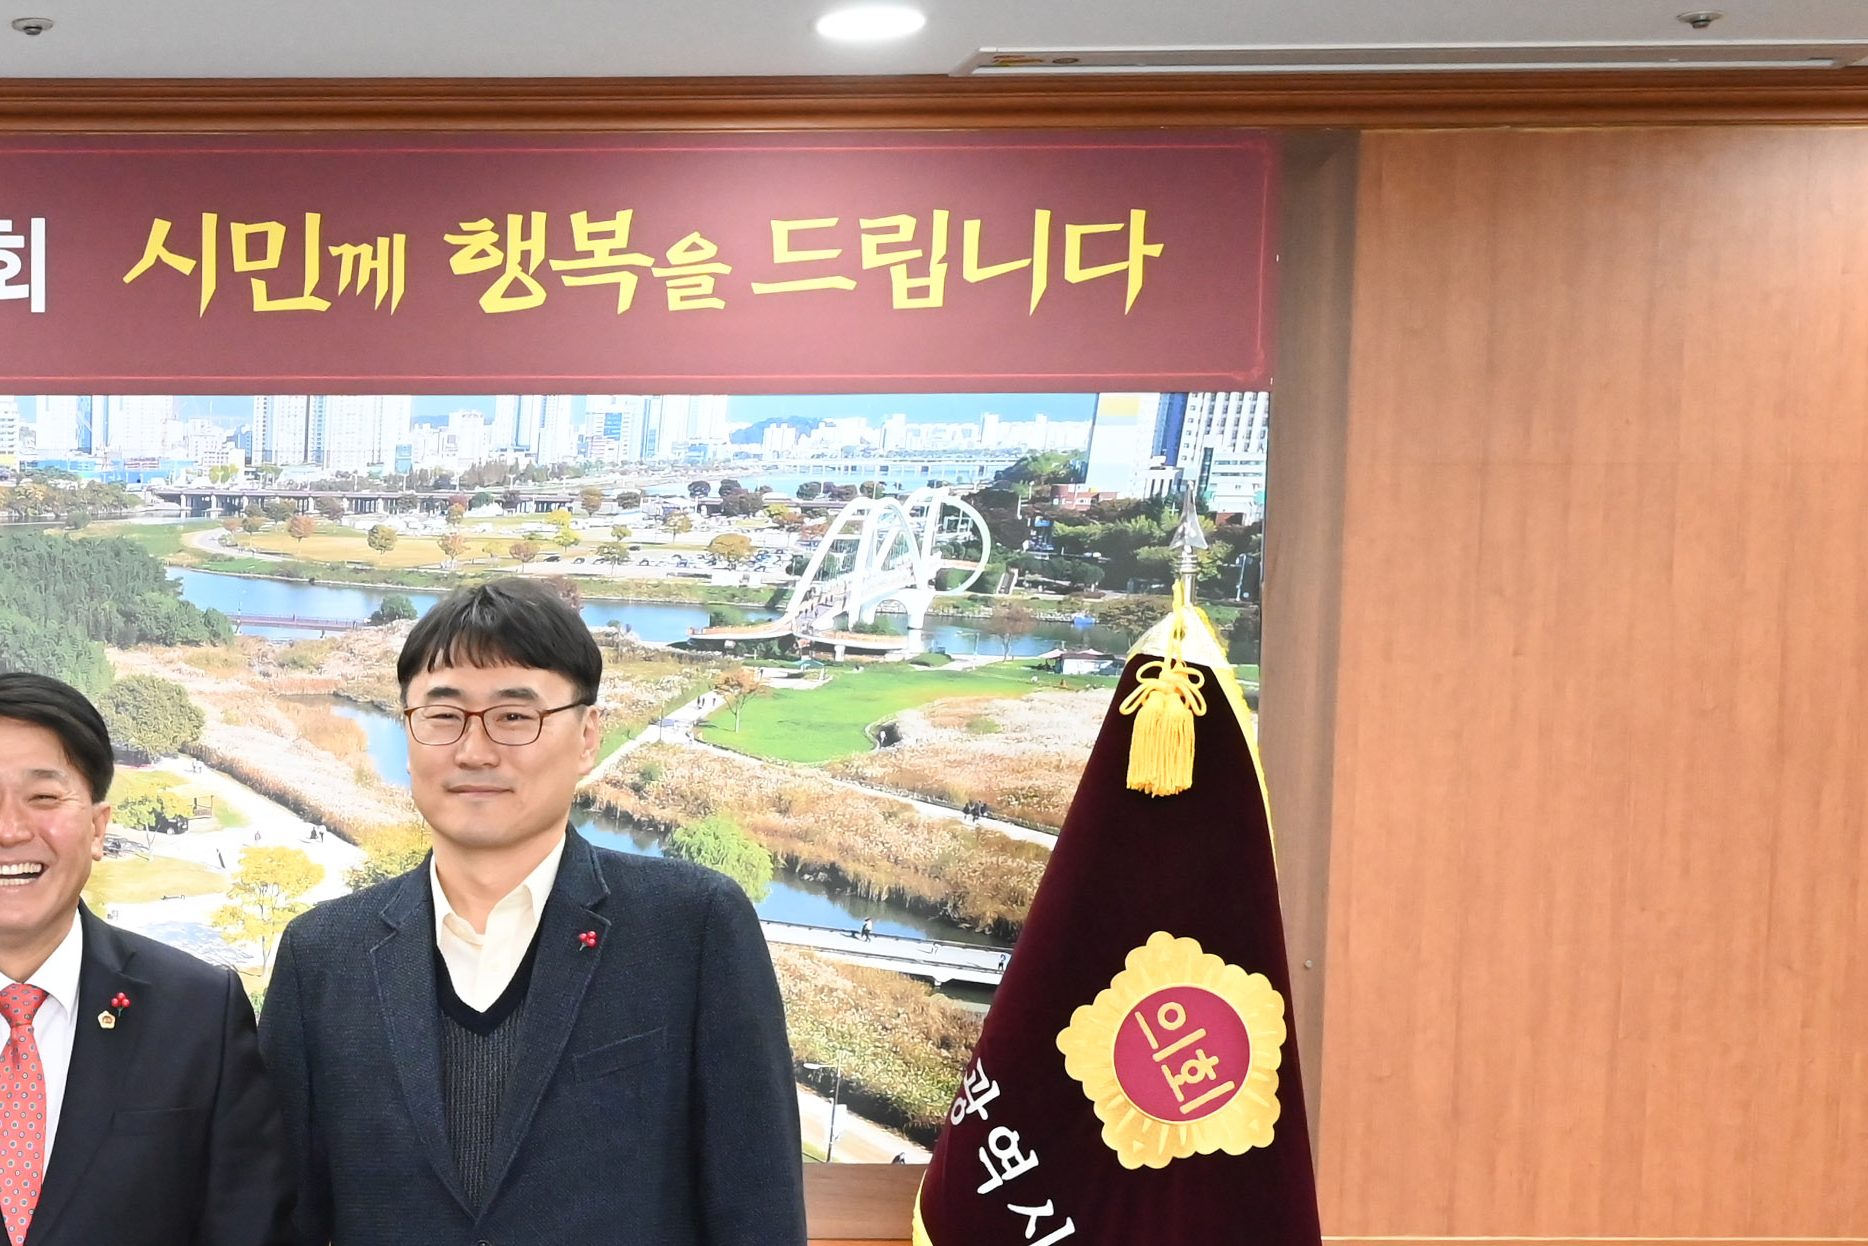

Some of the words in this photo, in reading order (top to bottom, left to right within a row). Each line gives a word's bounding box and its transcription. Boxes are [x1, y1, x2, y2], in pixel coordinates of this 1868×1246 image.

[122, 211, 406, 316] 시민께
[442, 207, 734, 315] 행복을
[751, 207, 1165, 316] 드립니다
[1134, 1001, 1236, 1115] 의회
